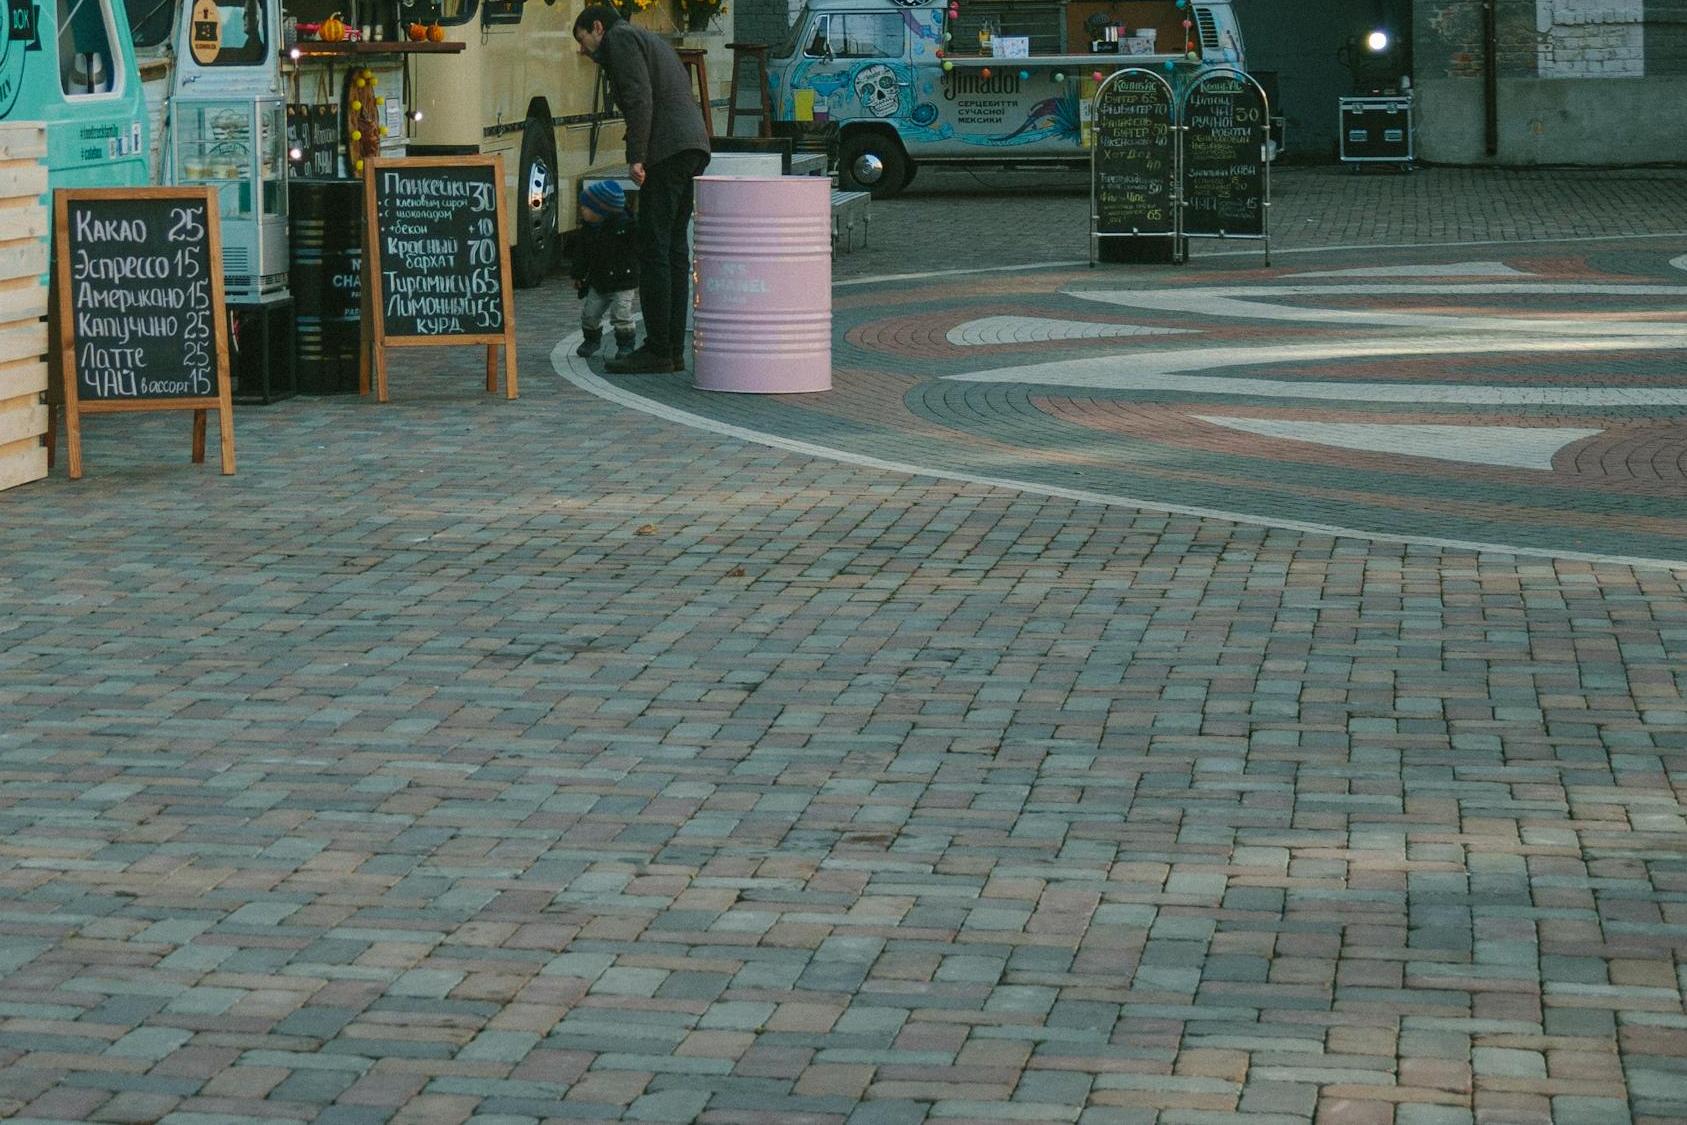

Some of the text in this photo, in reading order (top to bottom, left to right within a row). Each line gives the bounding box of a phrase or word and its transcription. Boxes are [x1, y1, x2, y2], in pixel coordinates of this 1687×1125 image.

[13, 8, 31, 30] BOX
[958, 100, 1018, 108] СЕРЦЕБИТТЯ
[1152, 103, 1167, 115] 70
[469, 181, 496, 213] 30
[167, 206, 205, 242] 25
[1147, 209, 1162, 221] 65
[74, 246, 201, 285] Эспрессо 15
[467, 238, 497, 266] 70
[77, 278, 210, 313] Американо 15
[332, 274, 362, 288] CHA
[383, 266, 501, 300] Тирамису 65
[78, 310, 211, 345] Капучино 25
[476, 296, 502, 328] 55
[81, 340, 210, 369] Латте 25
[85, 368, 138, 397] ЧАЙ
[188, 366, 212, 395] 15
